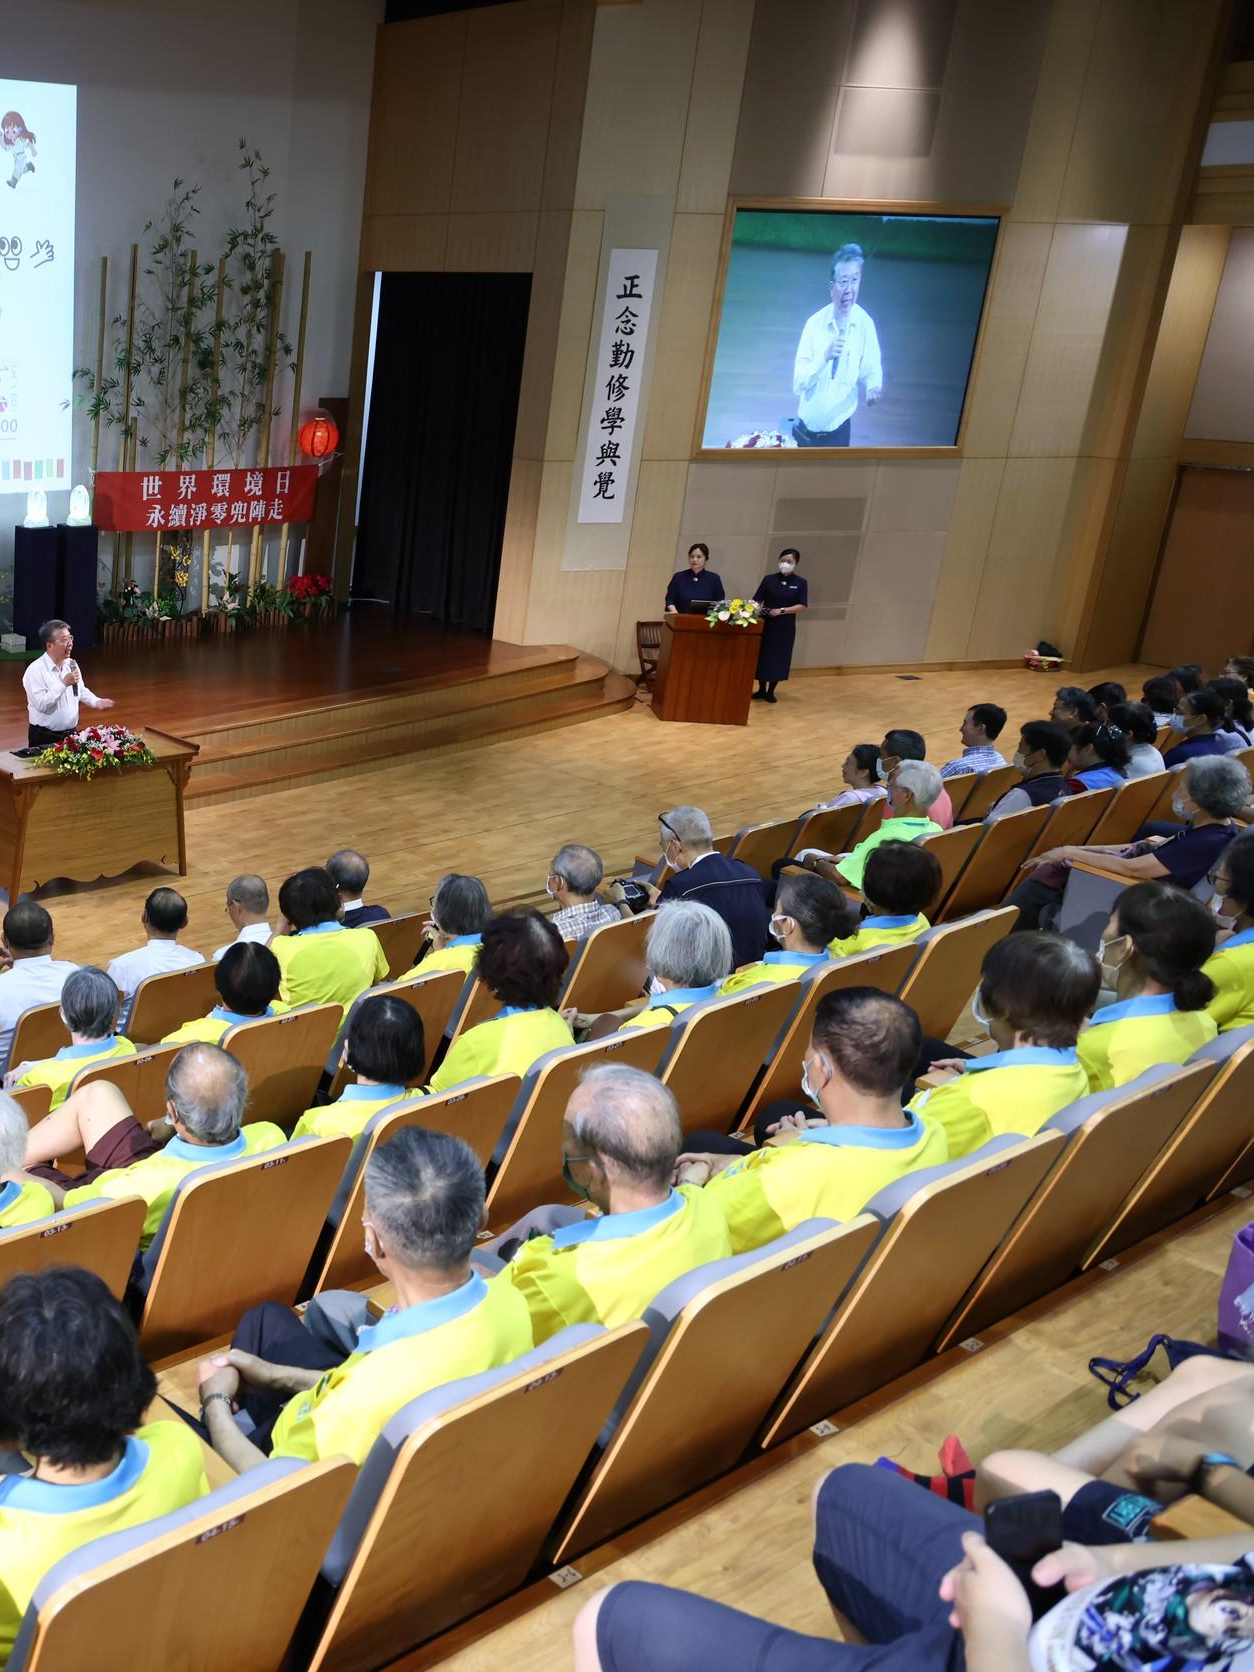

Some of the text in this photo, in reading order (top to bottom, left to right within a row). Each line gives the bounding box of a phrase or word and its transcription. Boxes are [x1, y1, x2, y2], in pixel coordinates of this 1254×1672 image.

[593, 274, 643, 500] 正念勤修學與覺
[140, 470, 291, 501] 世界環境日
[145, 498, 284, 529] 永續淨零兜陣走
